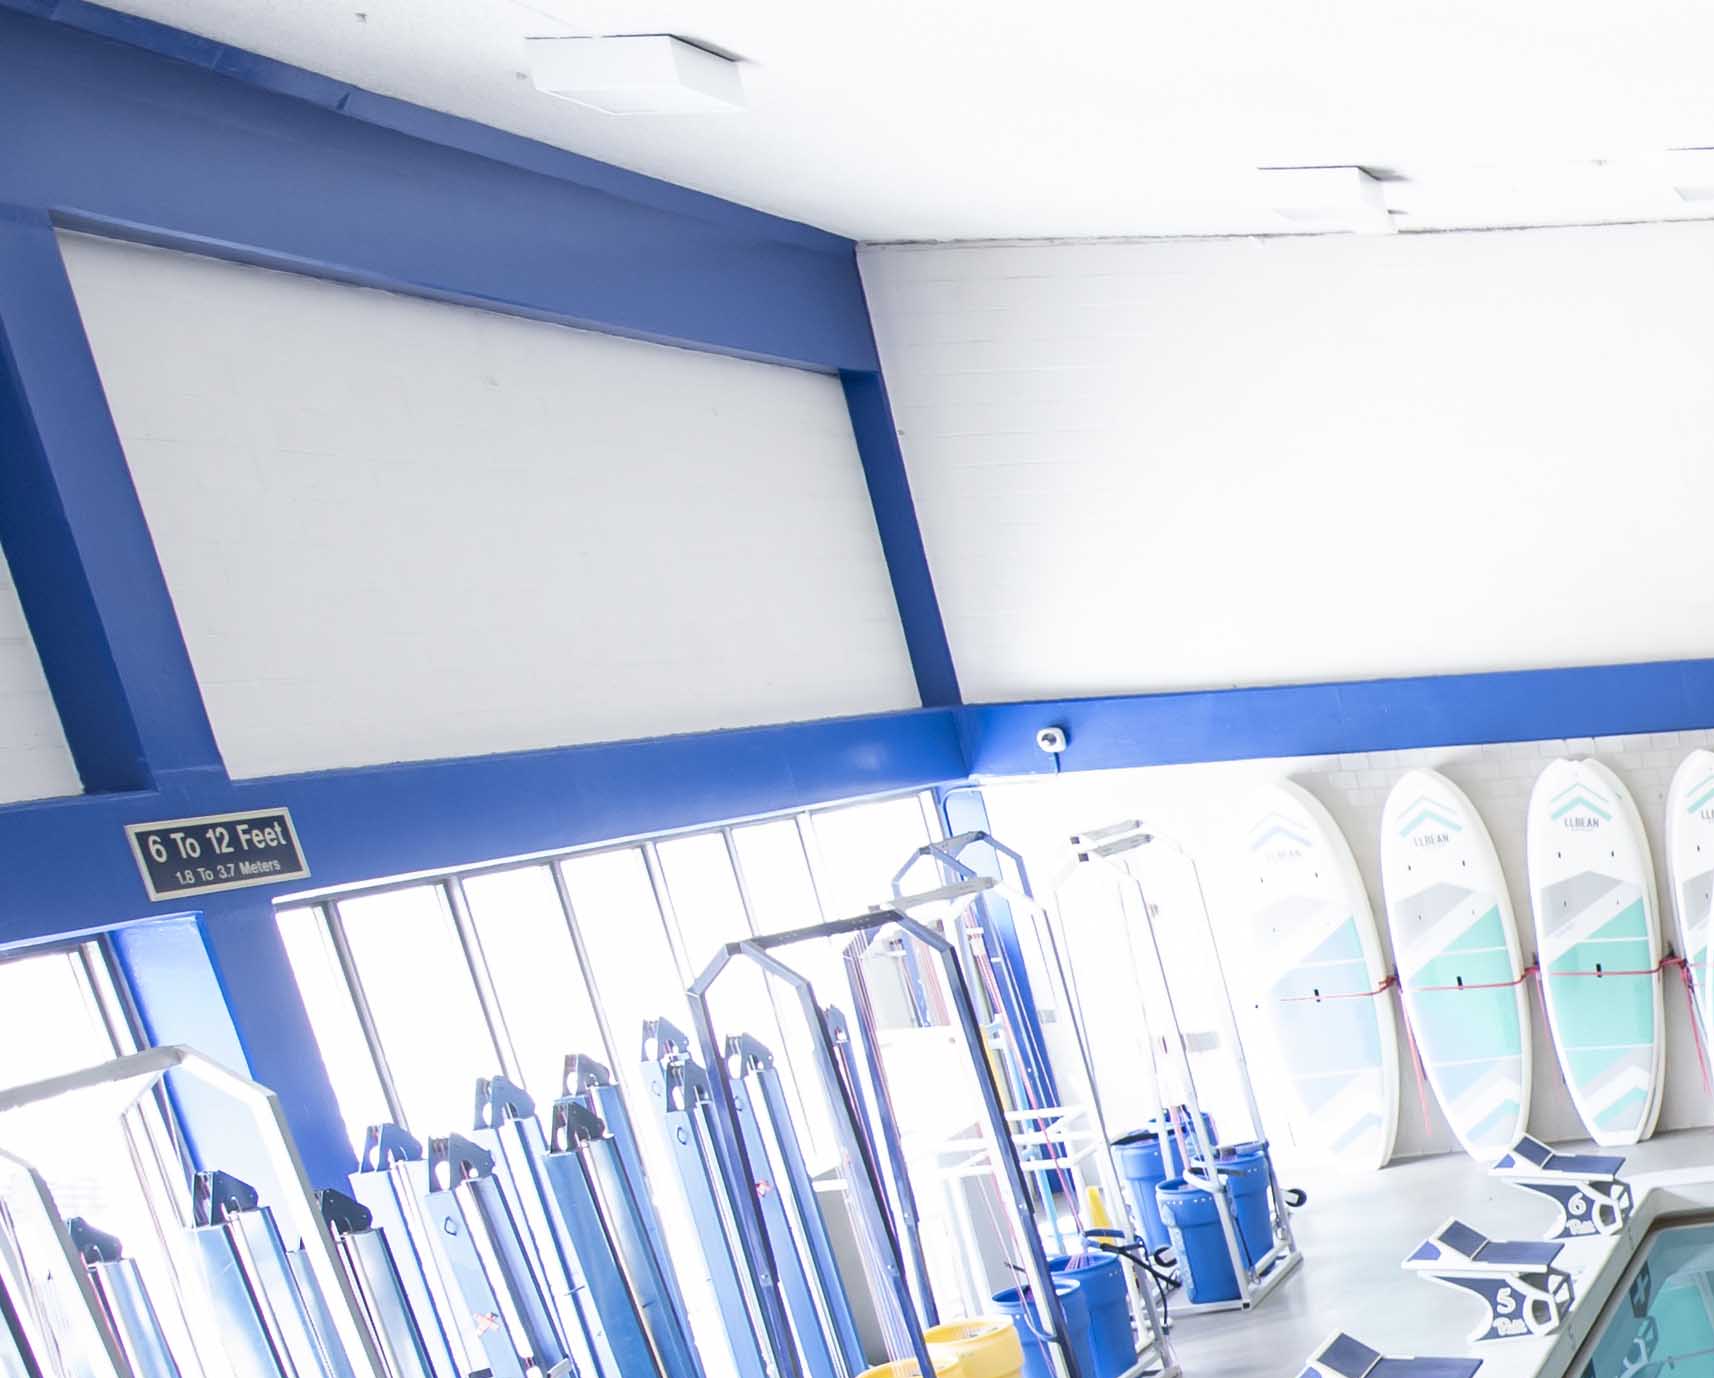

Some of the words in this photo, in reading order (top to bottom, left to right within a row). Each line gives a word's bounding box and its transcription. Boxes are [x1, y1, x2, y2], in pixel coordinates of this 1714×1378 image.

[148, 834, 168, 864] 6
[170, 832, 201, 859] To
[206, 826, 235, 855] 12
[236, 821, 287, 850] Feet
[175, 870, 196, 886] 1.8
[197, 867, 214, 882] To
[217, 864, 235, 879] 3.7
[239, 859, 281, 875] Meters
[1568, 1192, 1588, 1217] 6
[1496, 1287, 1517, 1315] 5
